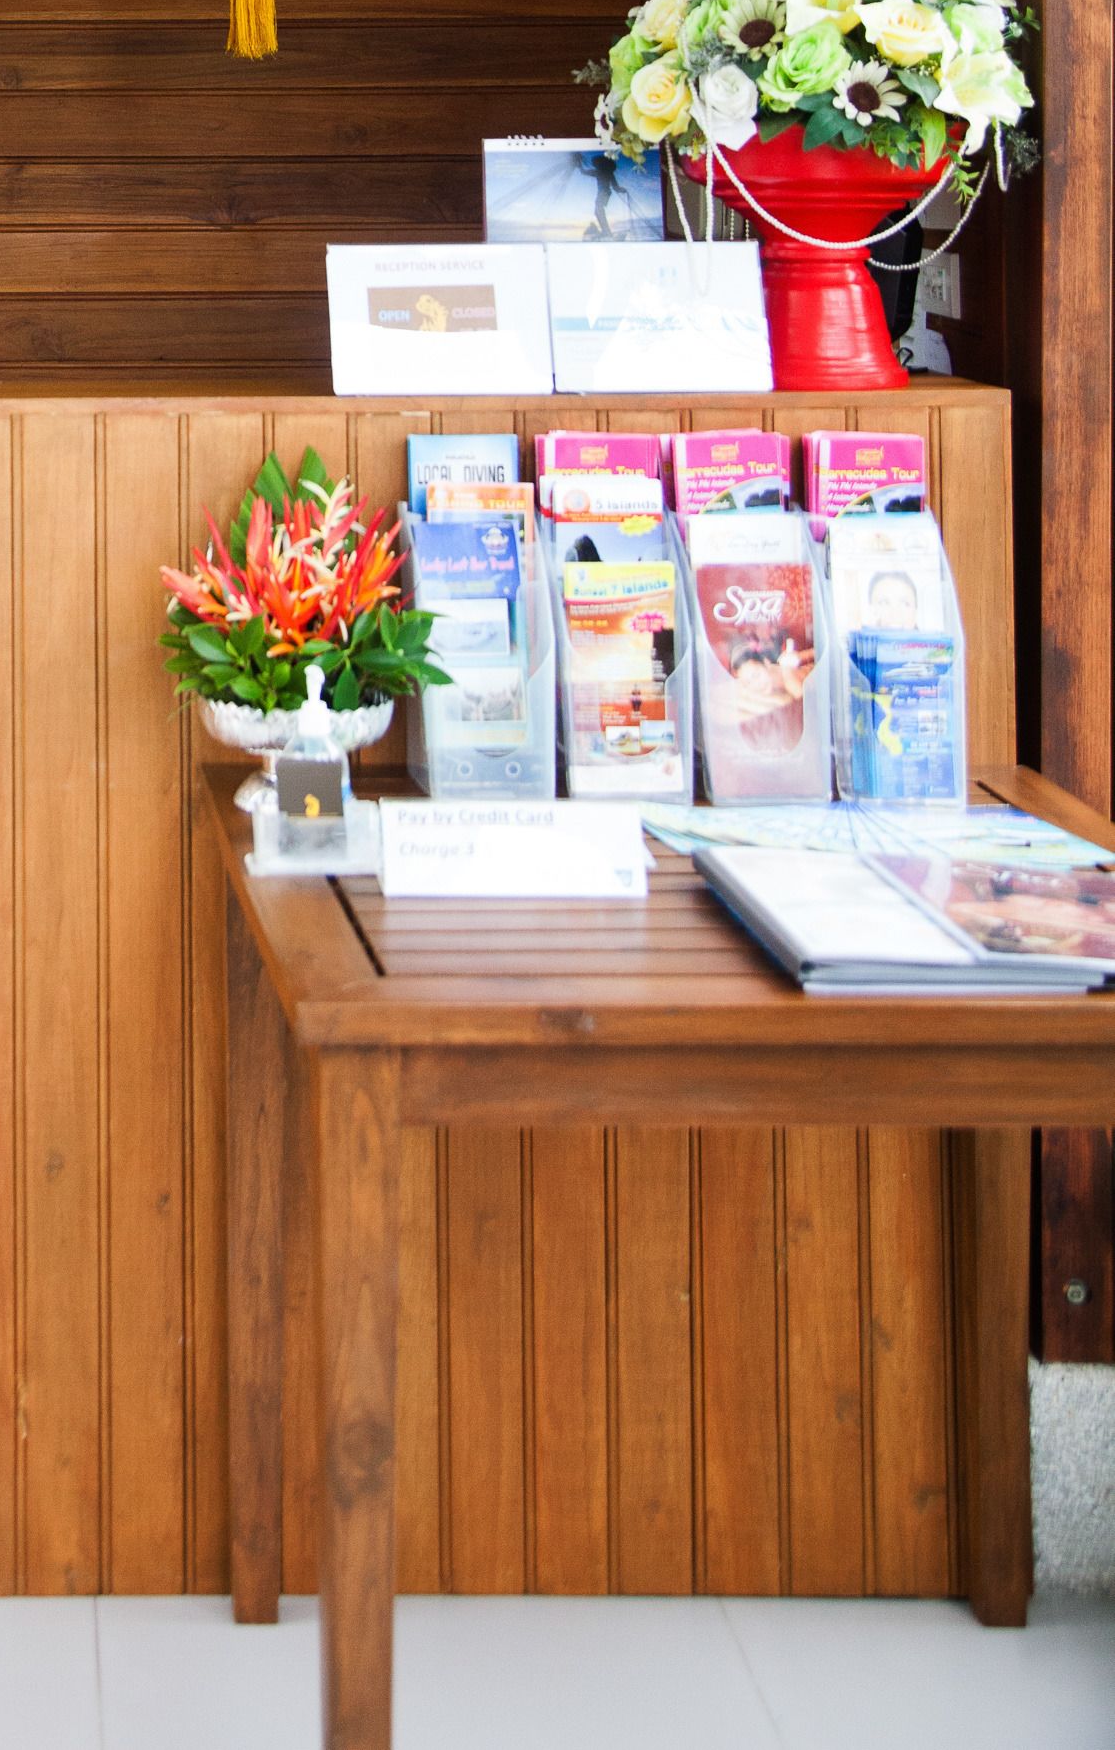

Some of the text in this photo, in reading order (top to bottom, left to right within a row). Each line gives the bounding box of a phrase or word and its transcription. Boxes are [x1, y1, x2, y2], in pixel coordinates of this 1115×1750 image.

[374, 260, 485, 272] RECEPTION SERVICE
[378, 309, 411, 322] OPEN
[417, 464, 506, 485] LOCAL DIVING
[748, 460, 777, 474] Tour
[890, 466, 920, 480] Tour
[713, 585, 786, 625] Spa
[397, 808, 555, 827] Pay by Credit Card
[399, 841, 459, 859] Charge
